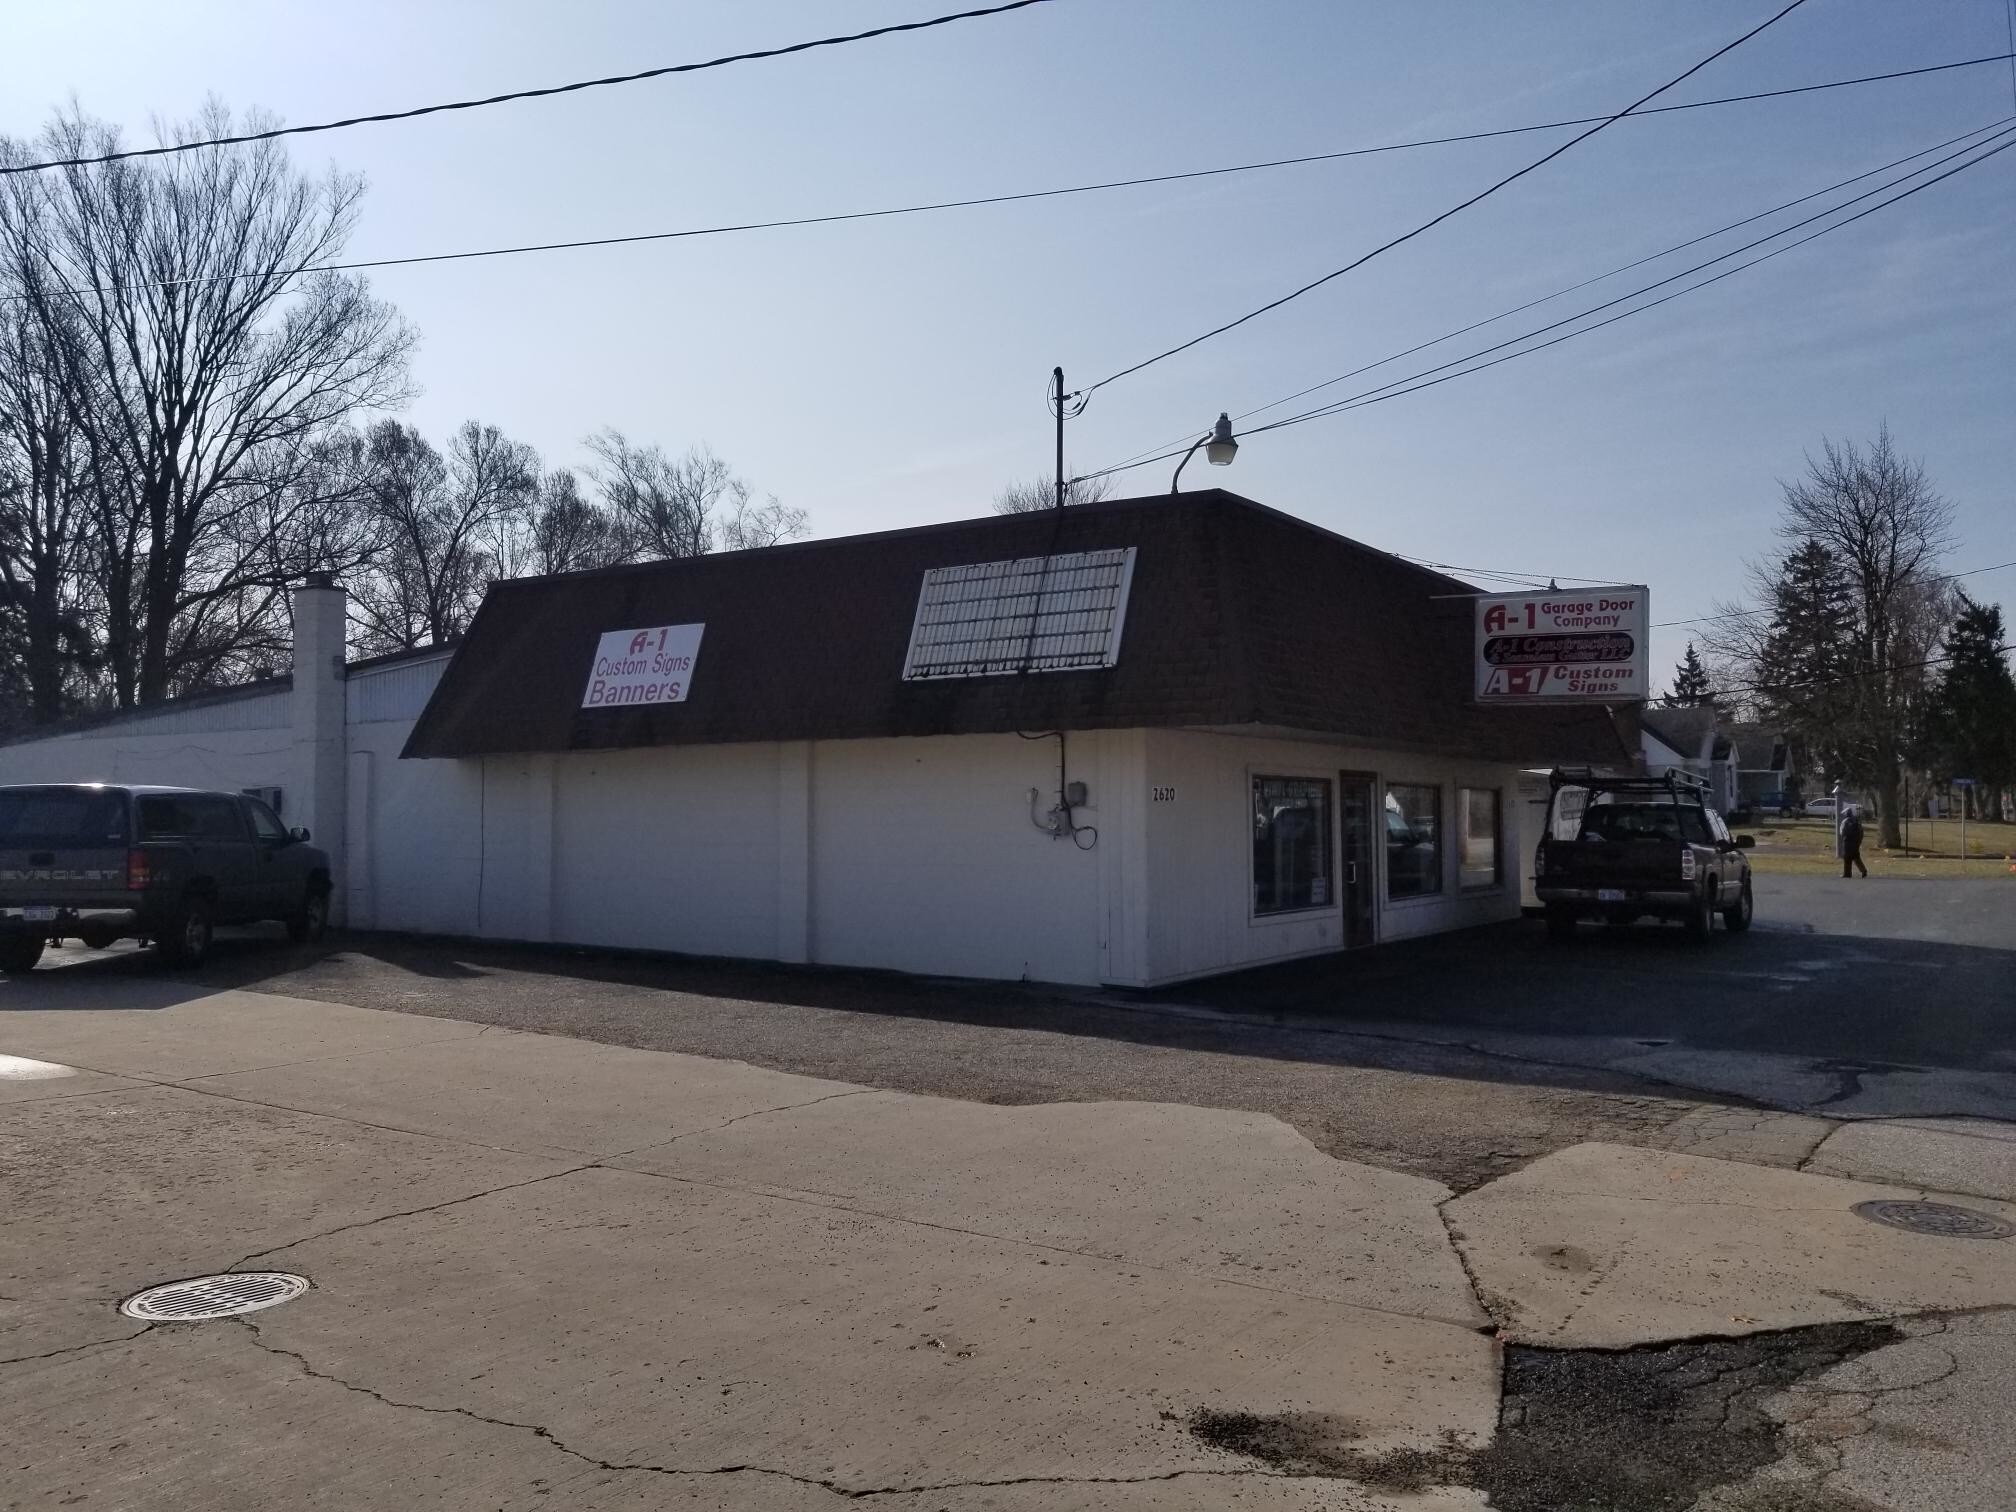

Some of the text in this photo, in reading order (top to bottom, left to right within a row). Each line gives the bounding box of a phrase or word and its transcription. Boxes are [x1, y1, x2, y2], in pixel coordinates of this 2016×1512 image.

[1484, 603, 1536, 634] A-1
[1541, 600, 1634, 615] Garage Door
[1554, 614, 1620, 628] Company
[630, 629, 668, 656] A-1
[596, 653, 691, 677] Custom Signs
[1554, 666, 1634, 680] Custom
[588, 680, 681, 705] Banners
[1484, 668, 1544, 694] A-1
[1568, 680, 1619, 693] Signs
